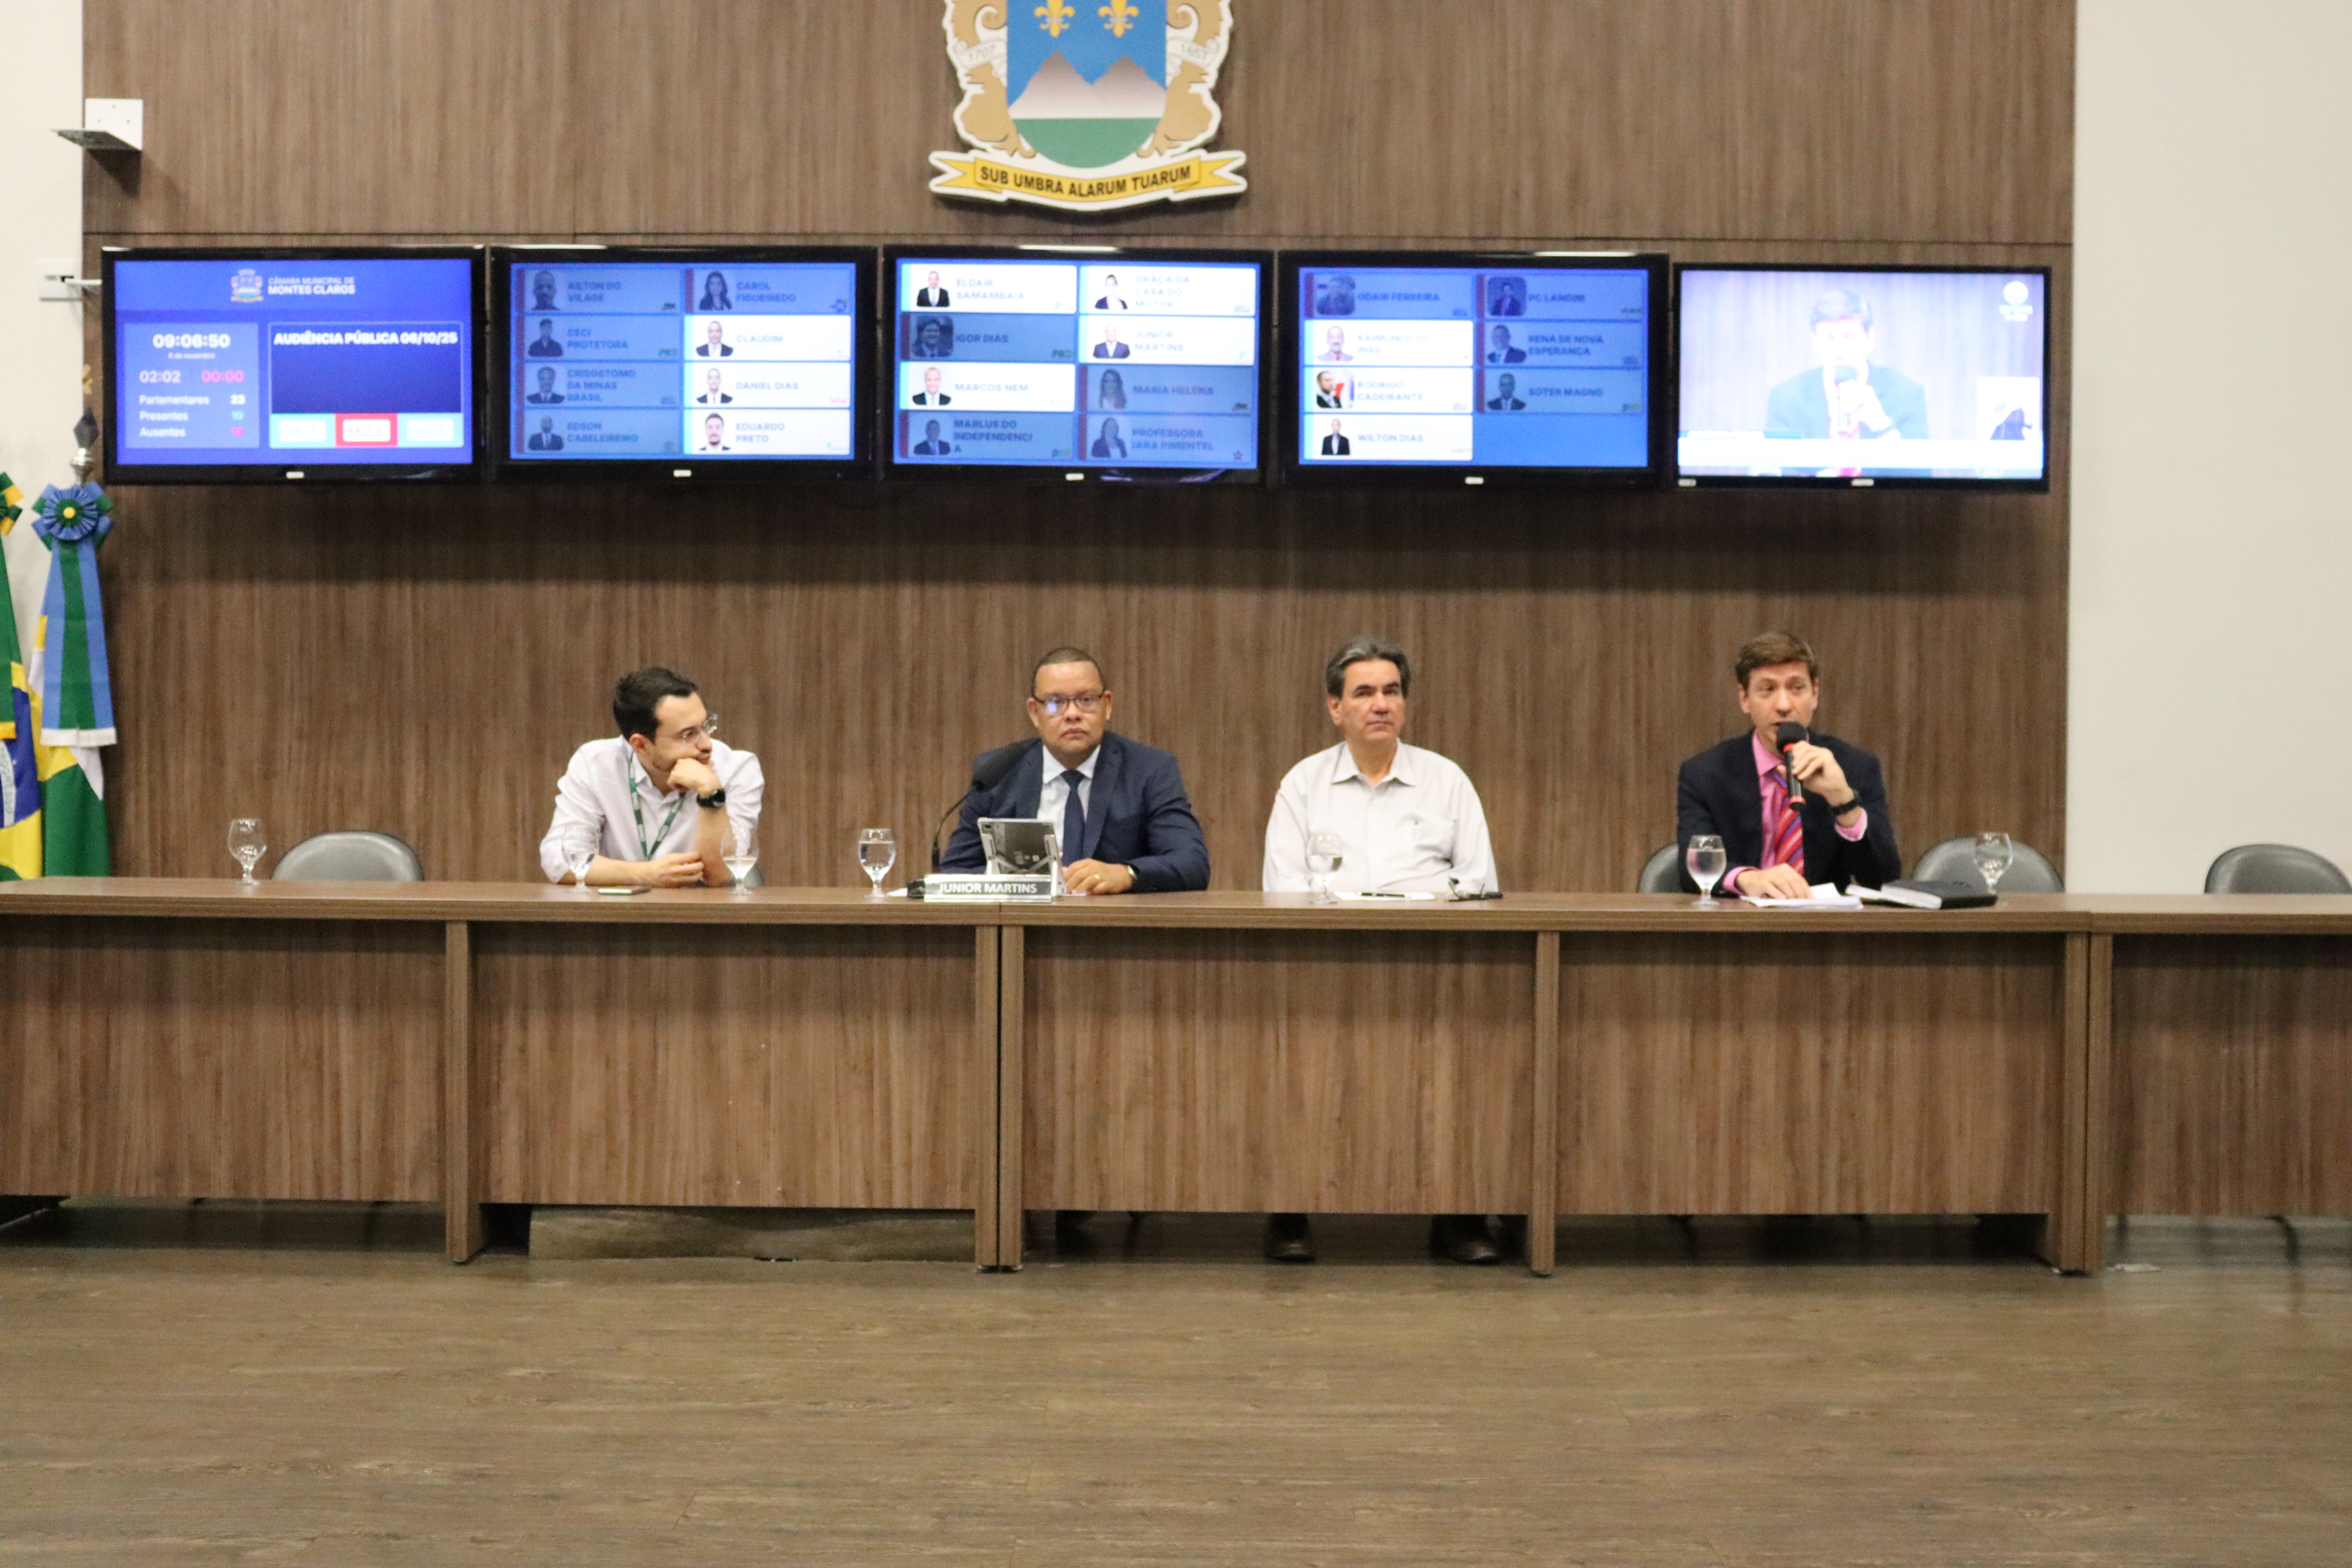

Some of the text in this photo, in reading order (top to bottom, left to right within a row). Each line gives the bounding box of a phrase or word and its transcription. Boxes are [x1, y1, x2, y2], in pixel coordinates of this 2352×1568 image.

[980, 166, 1191, 196] SUB UMBRA ALARUM TUARUM
[268, 276, 300, 284] CÂMARA
[956, 279, 993, 287] ELDAIR
[268, 285, 356, 295] MONTES CLAROS
[956, 291, 1024, 299] SAMAMBAIA
[152, 334, 231, 348] 09:06:50
[273, 330, 343, 345] AUDIÊNCIA
[344, 330, 399, 345] PÚBLICA
[1134, 344, 1184, 352] MARTINS
[139, 370, 181, 383] 02:02
[201, 369, 245, 383] 00:00
[736, 382, 772, 390] DANIEL
[955, 383, 1002, 392] MARCOS
[139, 395, 211, 405] Parlamentares
[139, 410, 189, 421] Presentes
[1002, 420, 1017, 429] DO
[140, 427, 186, 437] Ausentes
[938, 883, 1037, 893] JUNIOR MARTINS
